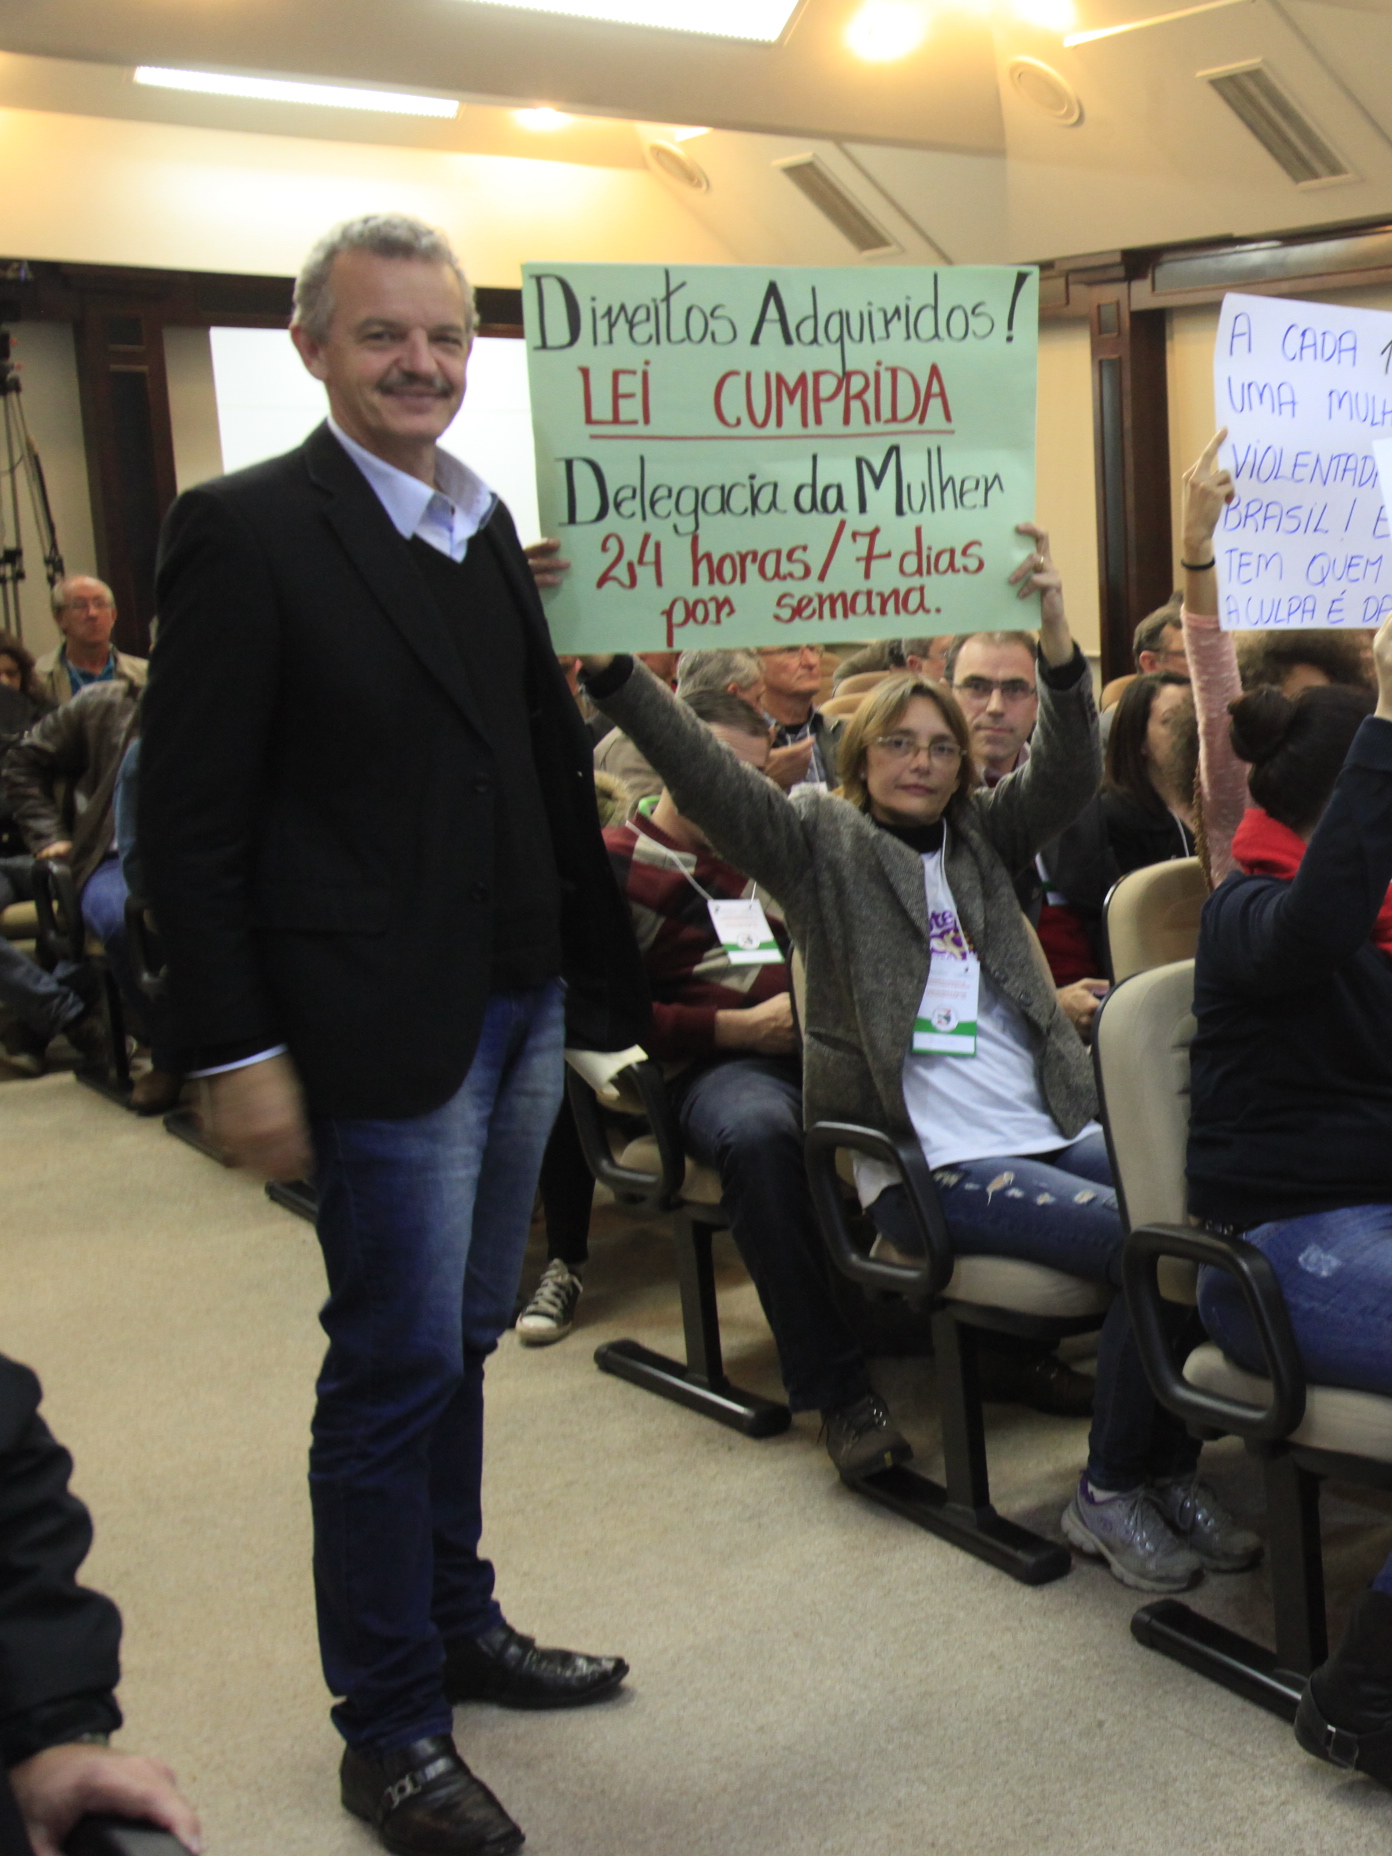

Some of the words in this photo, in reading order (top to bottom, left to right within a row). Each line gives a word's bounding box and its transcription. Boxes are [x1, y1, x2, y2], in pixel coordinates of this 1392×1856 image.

[530, 268, 738, 350] Direitos
[750, 271, 1033, 379] Adquiridos!
[1229, 312, 1251, 356] A
[1282, 323, 1357, 367] CADA
[713, 360, 952, 428] CUMPRIDA
[1228, 375, 1296, 418] UMA
[555, 456, 781, 536] Delegacia
[794, 453, 848, 516] da
[856, 444, 1004, 517] Mulher
[597, 532, 663, 590] 24
[900, 525, 985, 578] dias
[1224, 547, 1284, 585] TEM
[1305, 551, 1384, 587] QUEM
[661, 595, 736, 648] por
[773, 585, 941, 624] semana.
[1327, 589, 1347, 625] É
